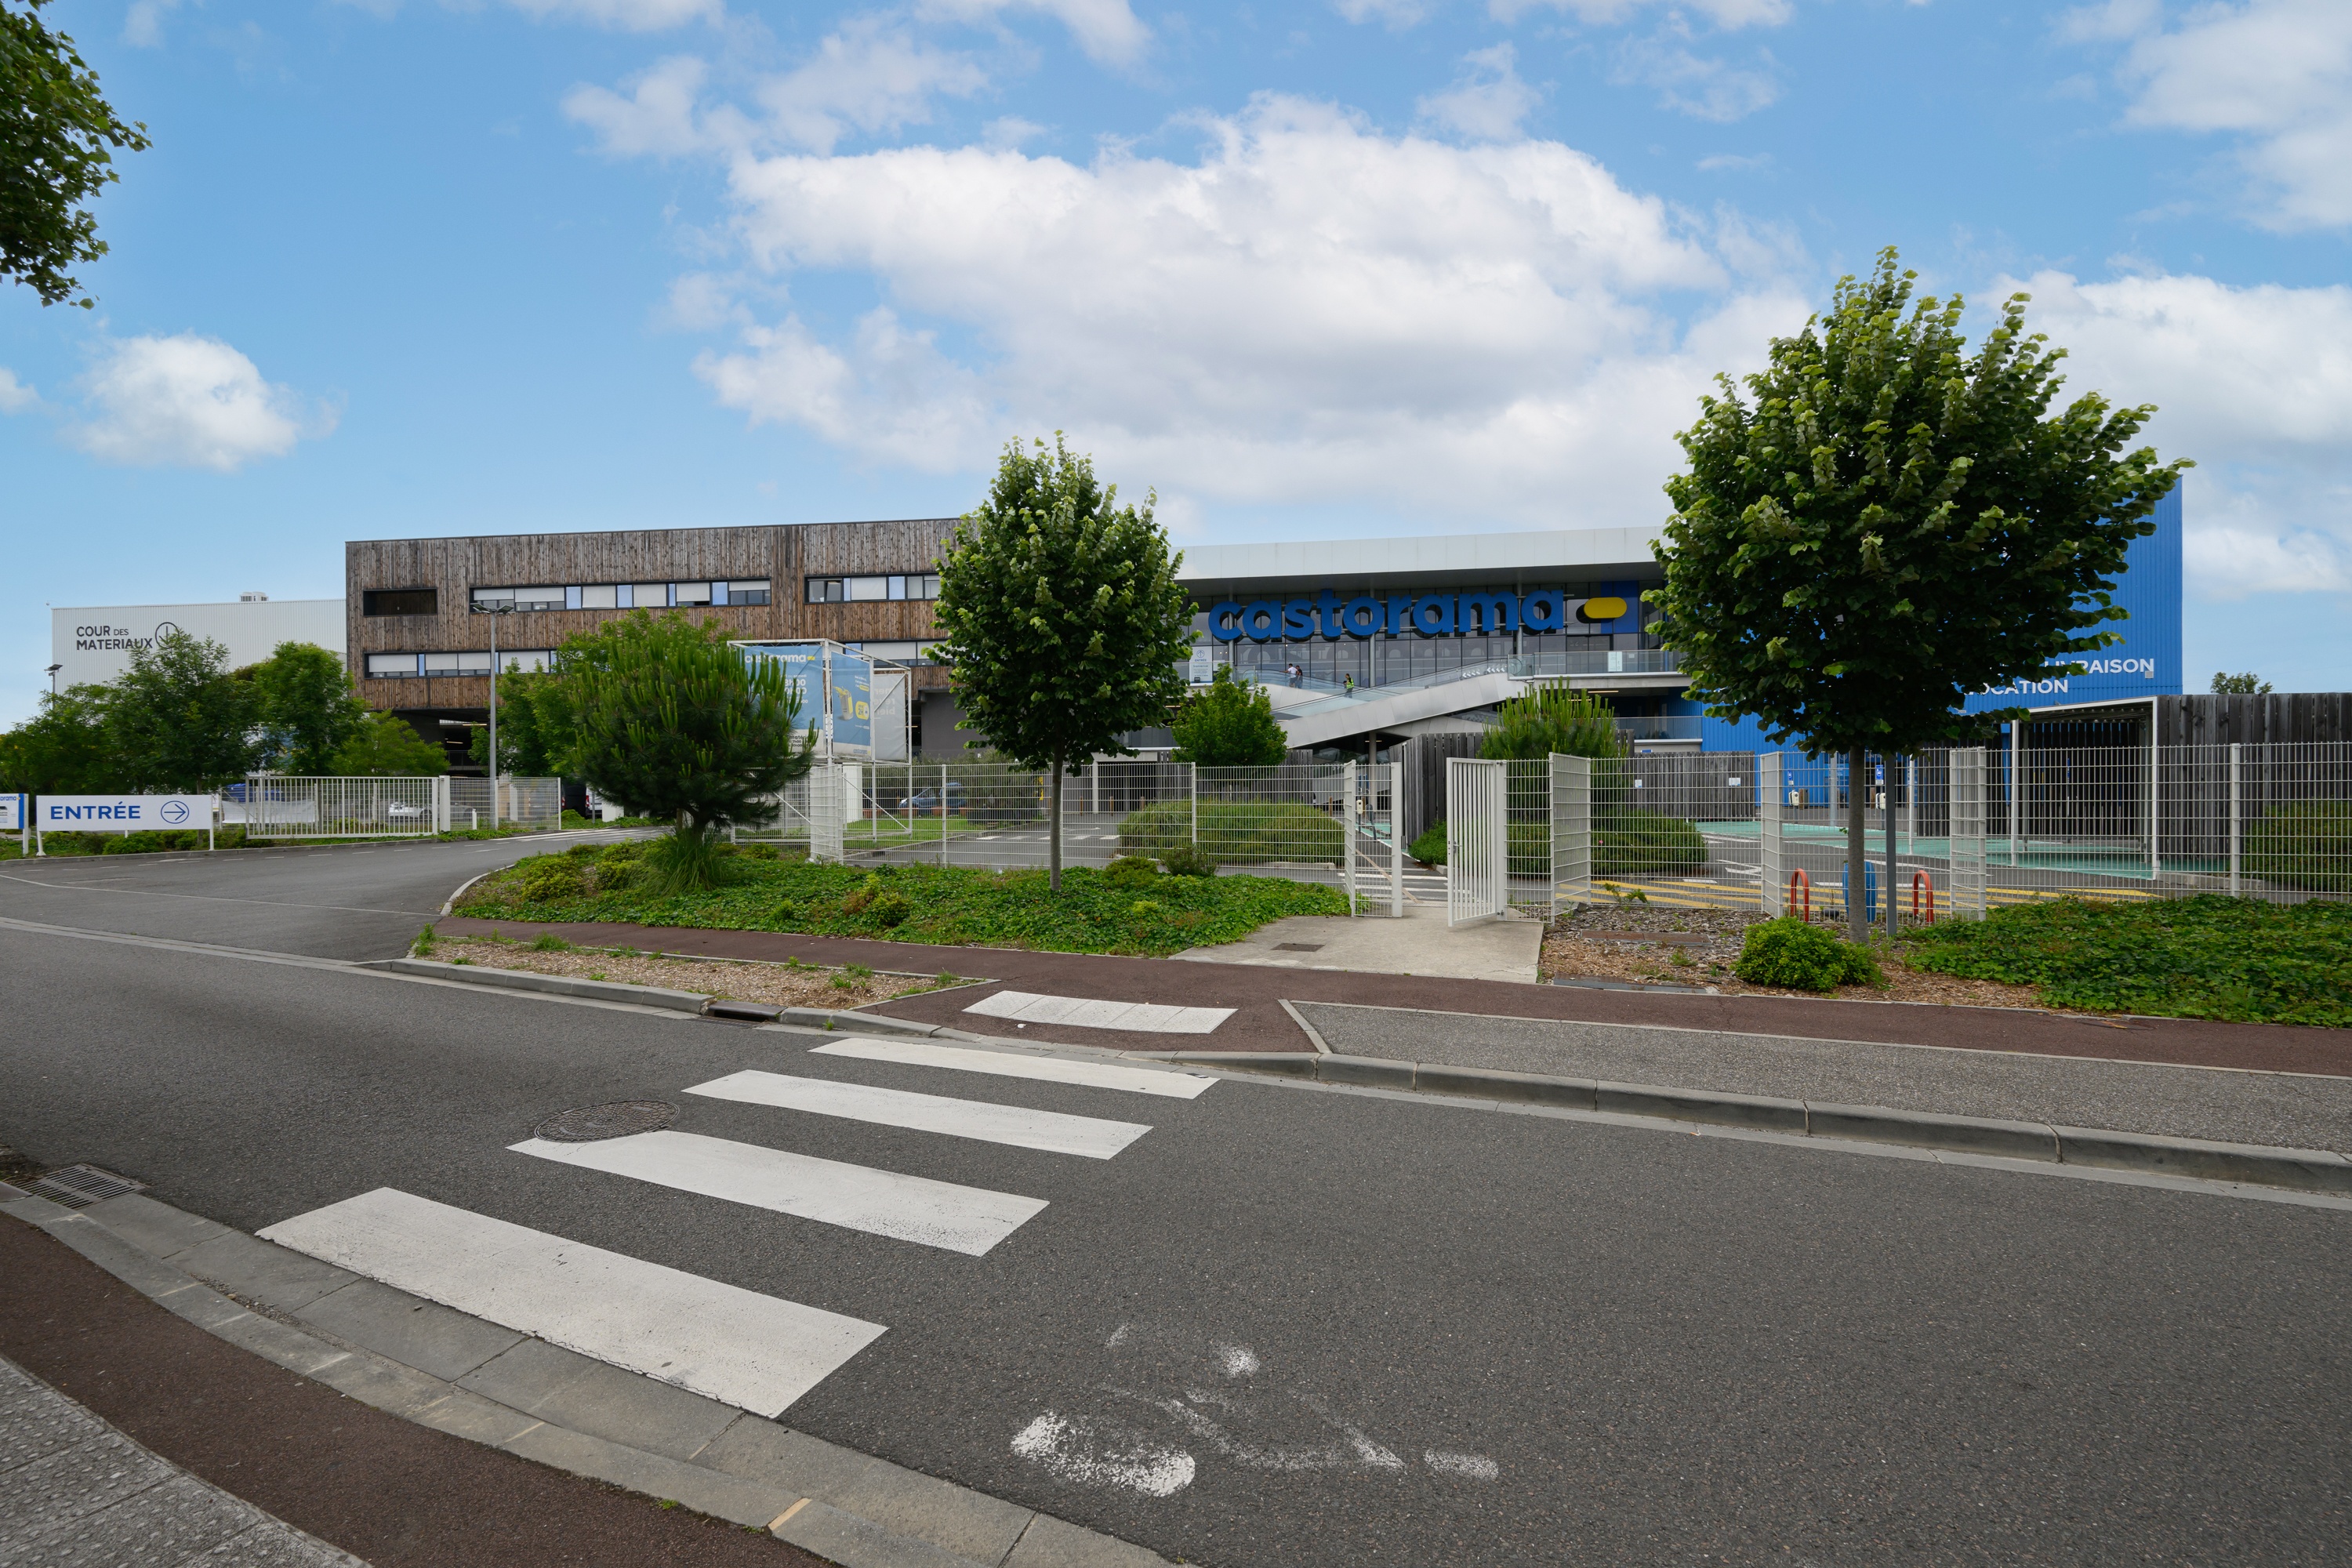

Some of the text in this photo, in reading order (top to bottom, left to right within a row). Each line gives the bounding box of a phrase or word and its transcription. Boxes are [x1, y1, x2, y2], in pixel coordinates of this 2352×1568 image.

[1208, 589, 1564, 641] castorama
[77, 625, 111, 637] COUR
[76, 637, 154, 650] MATERIAUX
[745, 653, 807, 663] casorama
[1963, 679, 2068, 695] OCATION
[50, 800, 141, 820] ENTRÉE
